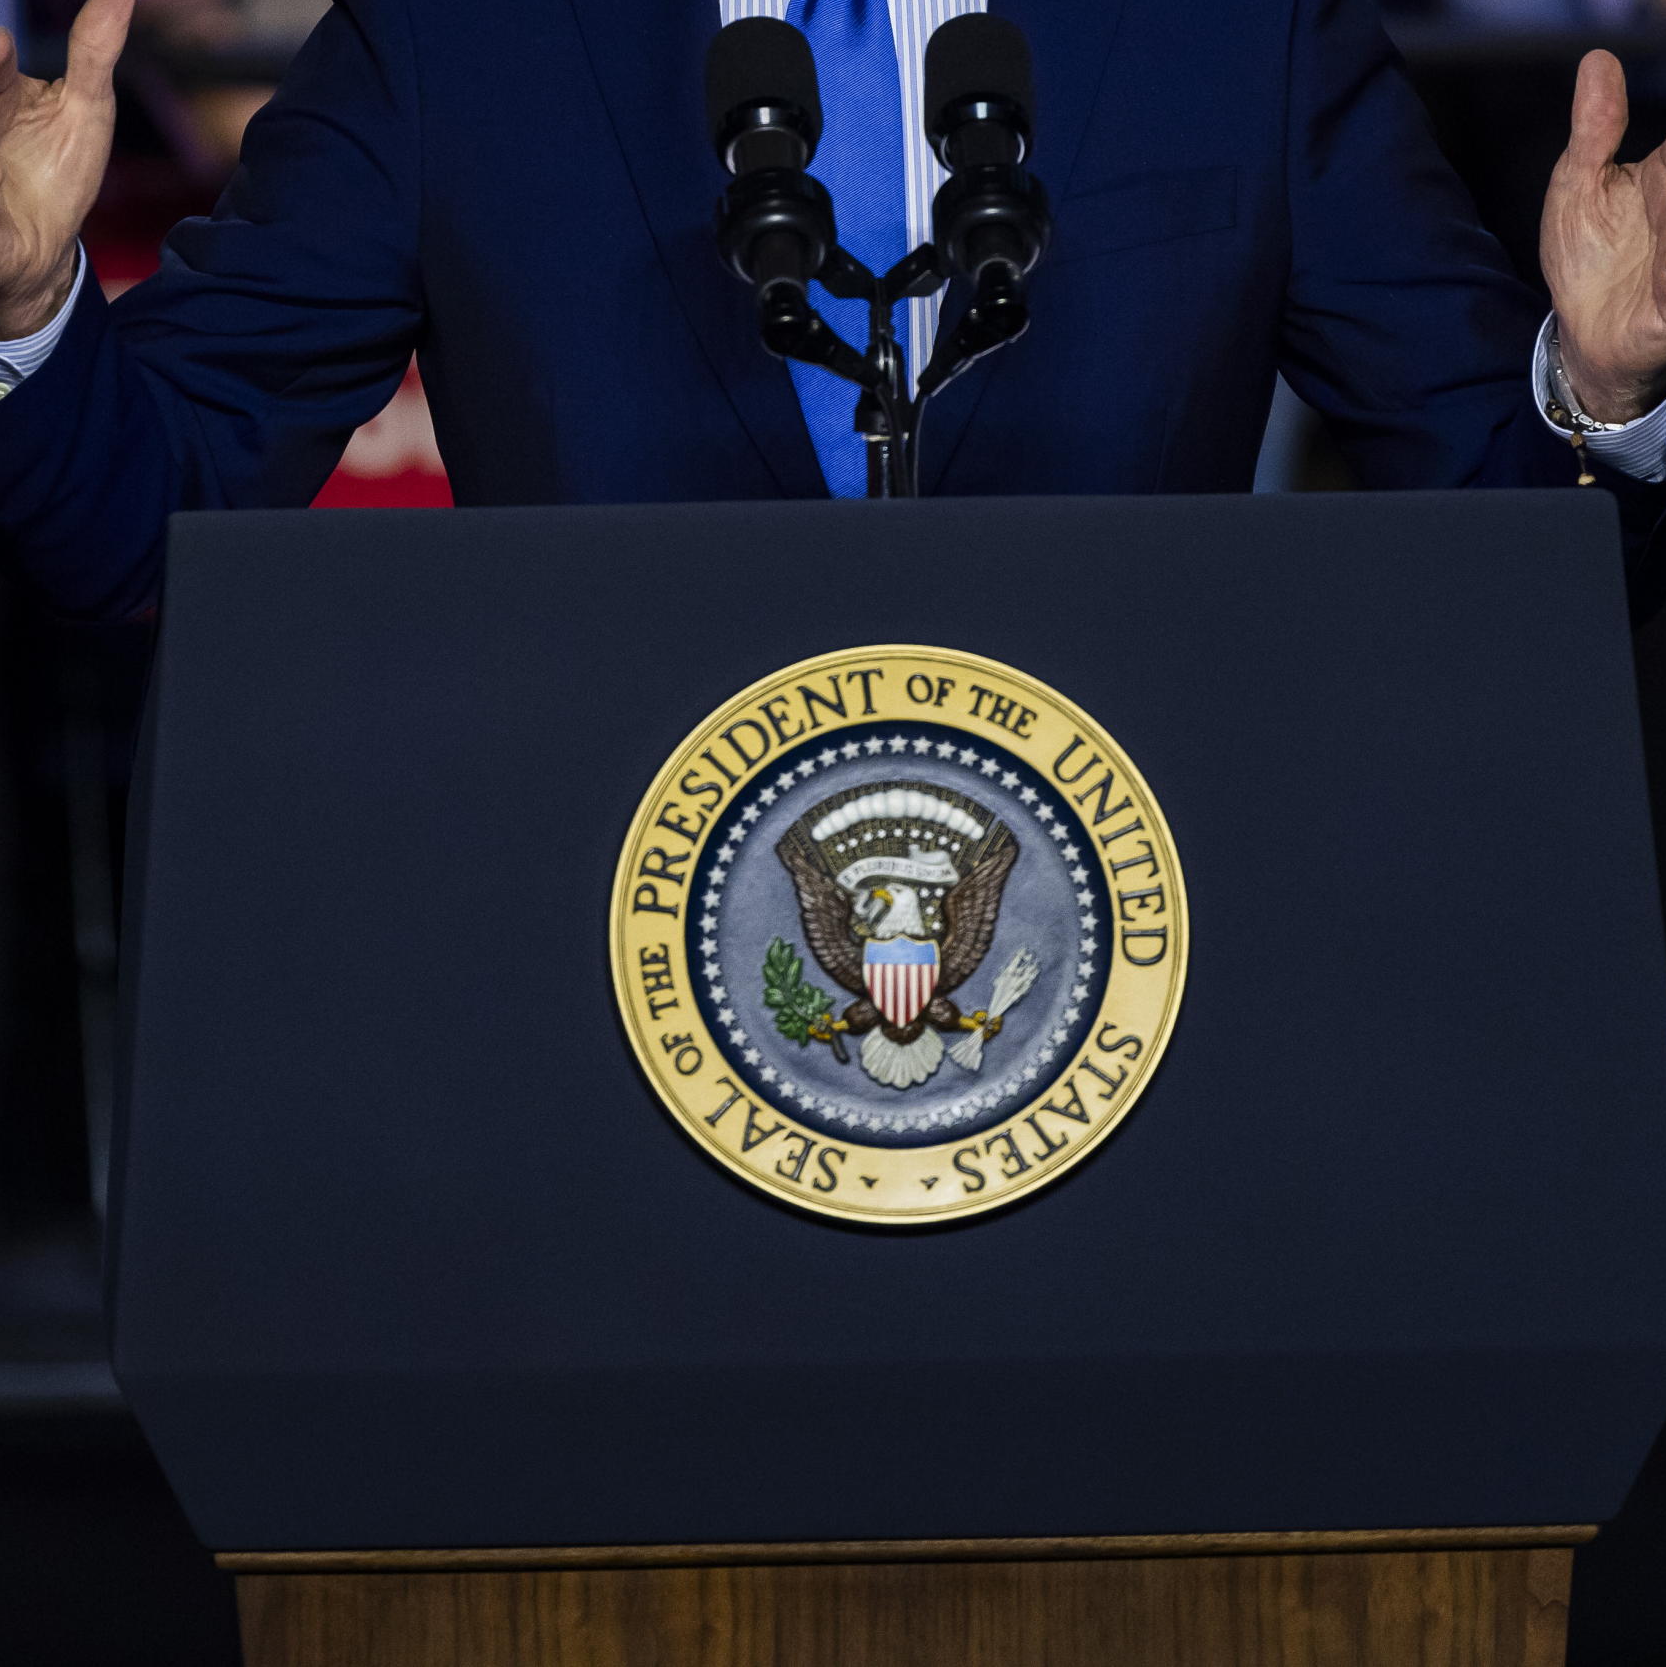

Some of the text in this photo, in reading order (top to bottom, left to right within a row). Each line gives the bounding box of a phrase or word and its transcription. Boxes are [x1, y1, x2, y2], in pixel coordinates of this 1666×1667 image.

[633, 668, 1168, 1194] SEAL OF THE PRESIDENT OF THE UNITED STATES
